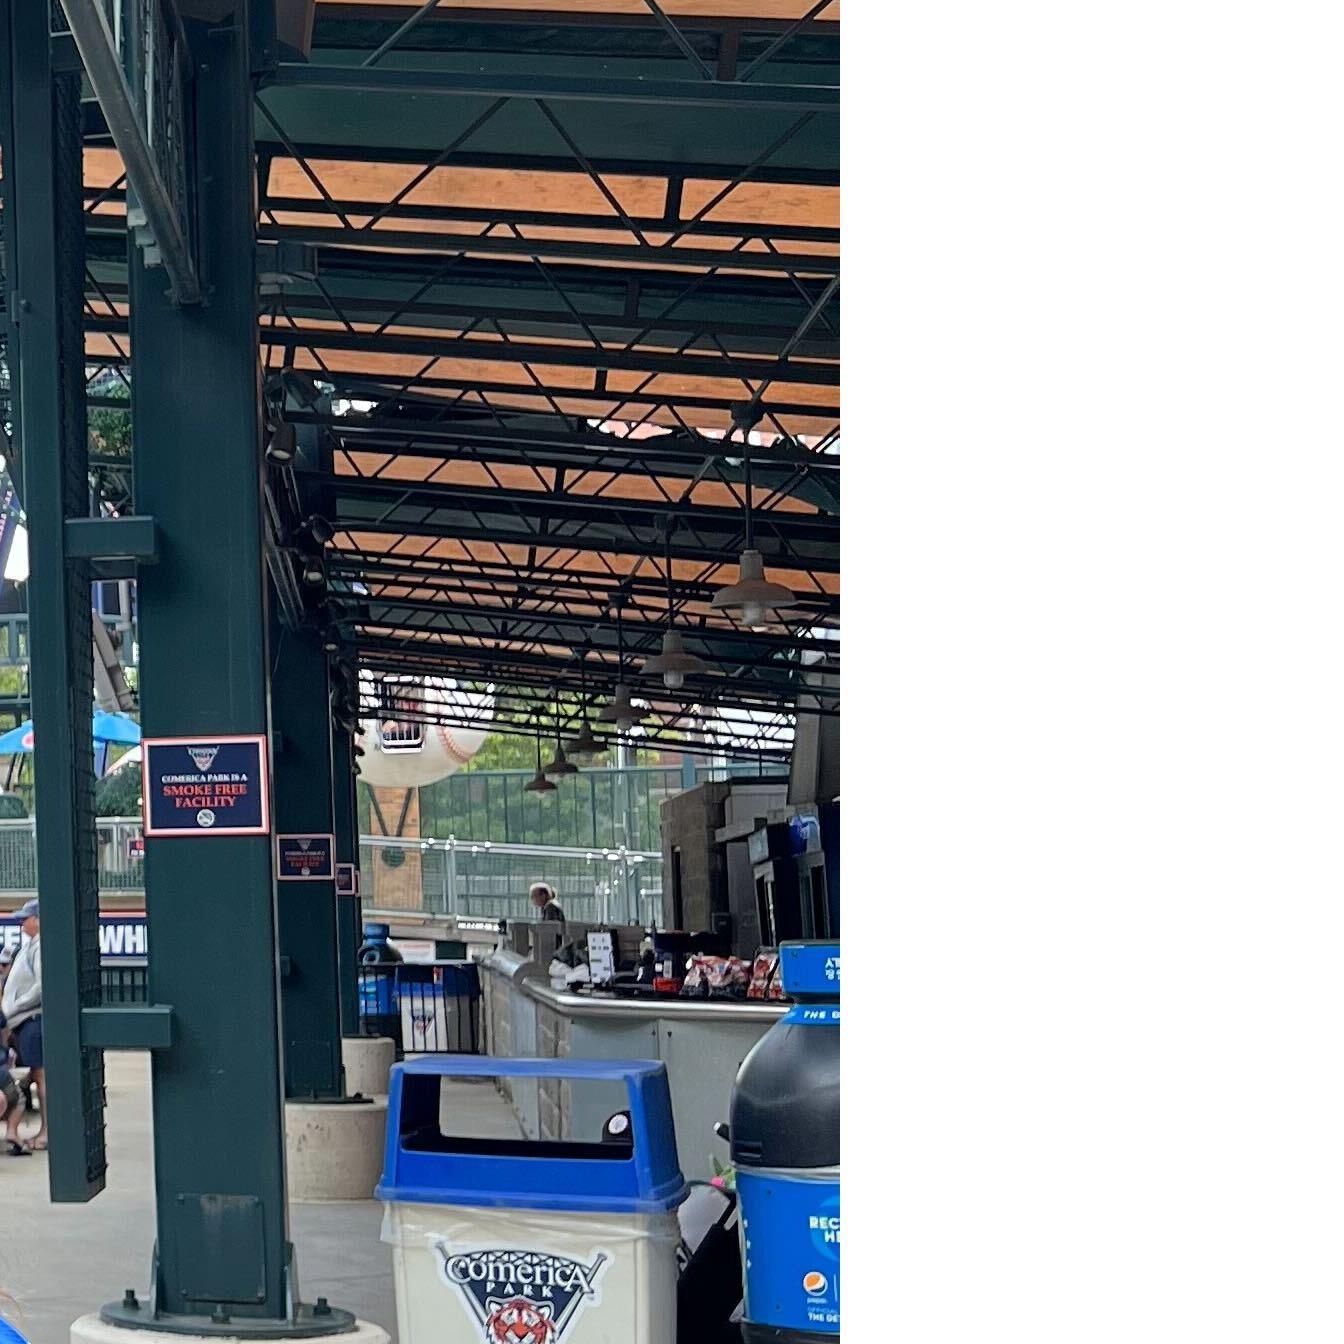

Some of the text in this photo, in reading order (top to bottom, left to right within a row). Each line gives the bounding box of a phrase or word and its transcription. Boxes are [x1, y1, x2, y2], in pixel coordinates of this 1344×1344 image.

[161, 774, 206, 784] COMERICA
[207, 773, 229, 783] PARK
[240, 773, 248, 782] A
[163, 783, 248, 797] SMOKE FREE
[175, 796, 236, 808] FACILITY
[804, 1010, 827, 1020] THE
[486, 1282, 554, 1298] PARK
